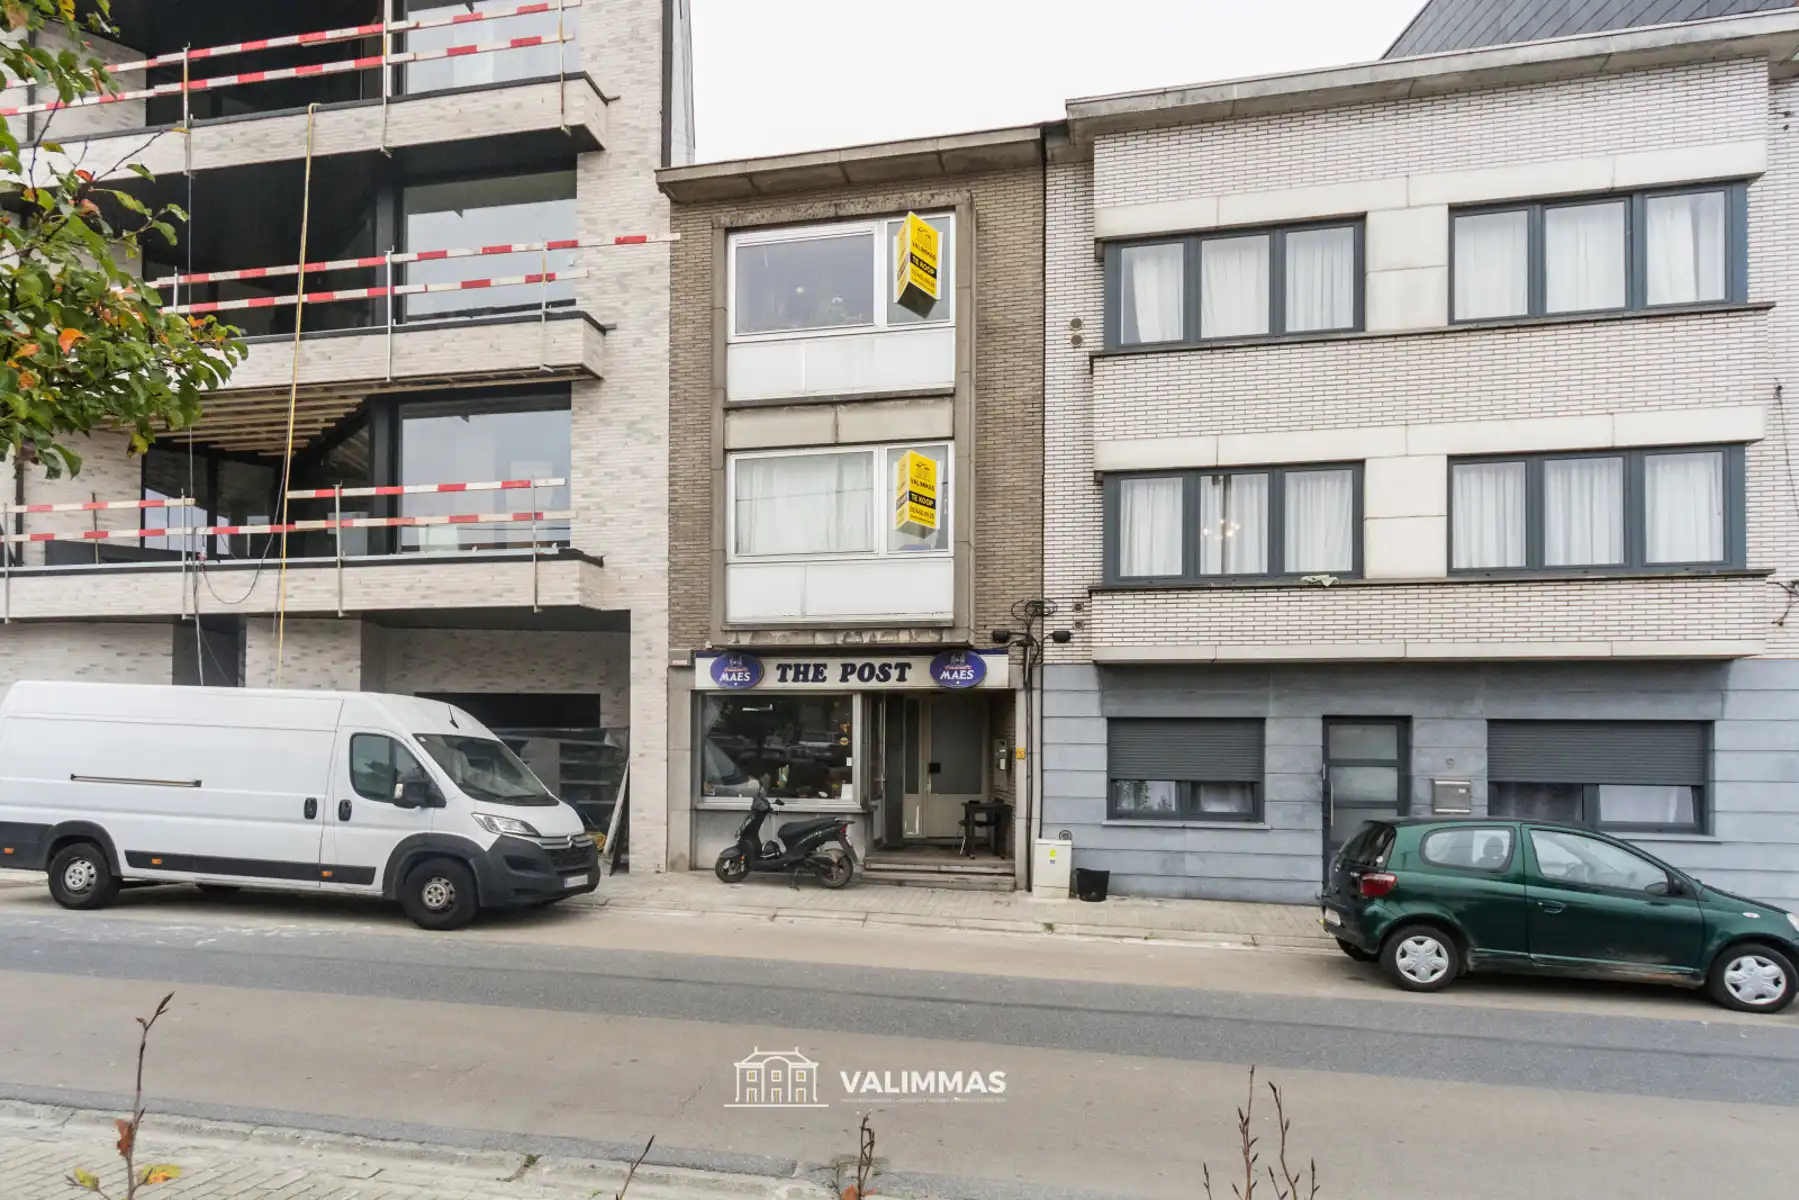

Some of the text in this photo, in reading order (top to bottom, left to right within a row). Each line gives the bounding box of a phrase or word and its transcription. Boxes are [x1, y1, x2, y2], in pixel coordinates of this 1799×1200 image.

[918, 495, 934, 507] KOOP
[719, 672, 751, 682] MAES
[776, 662, 912, 683] THE POST
[940, 669, 975, 680] MAES
